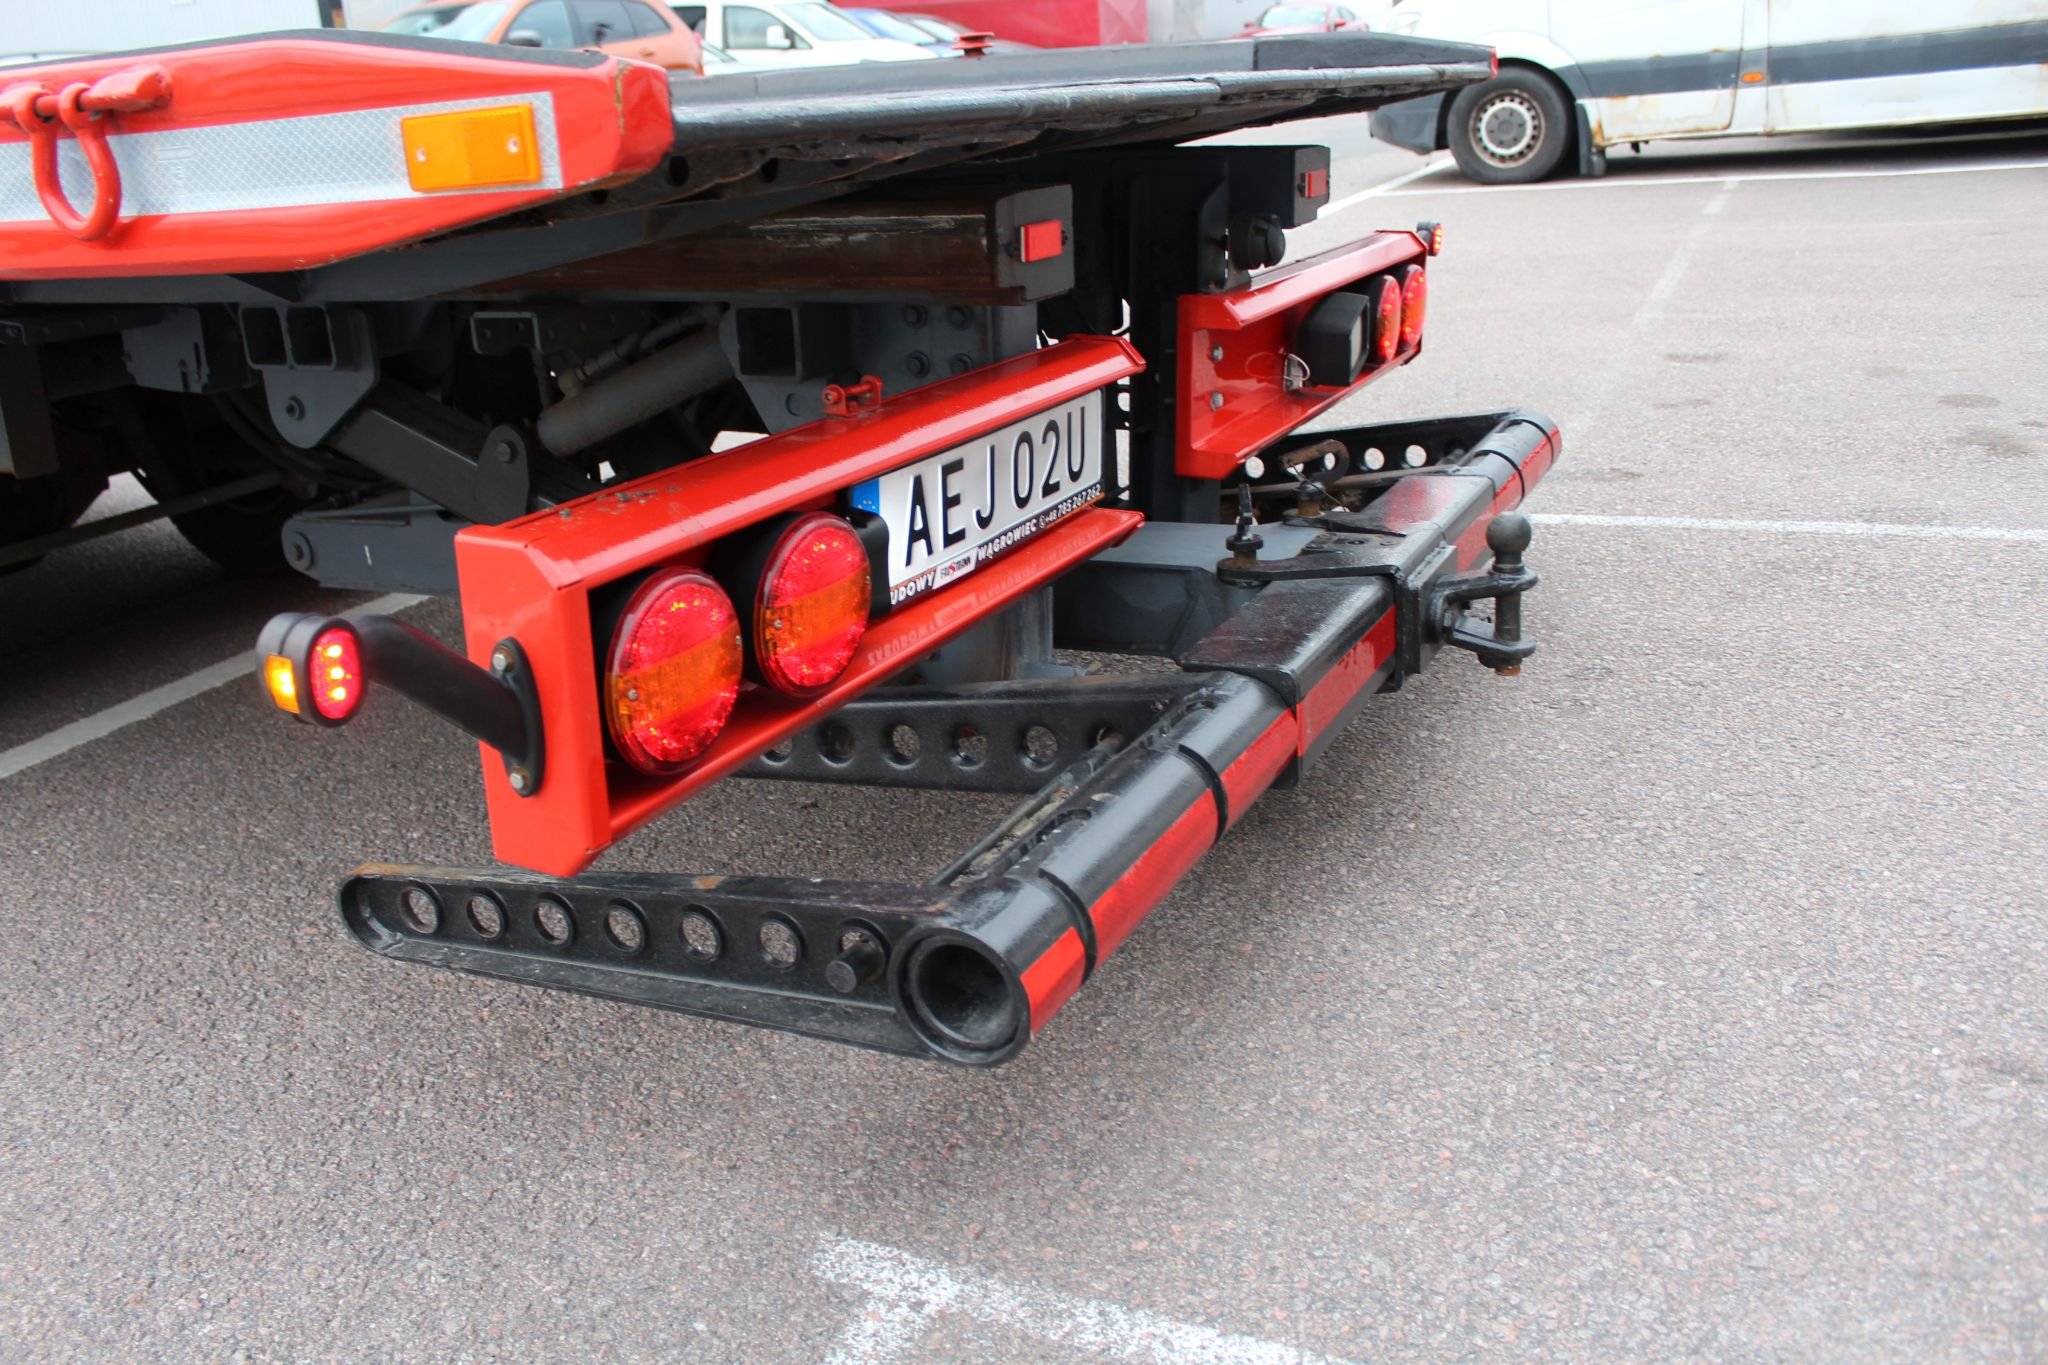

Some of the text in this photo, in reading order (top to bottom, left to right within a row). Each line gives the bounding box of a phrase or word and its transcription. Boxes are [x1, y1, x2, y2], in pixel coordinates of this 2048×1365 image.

[890, 571, 935, 605] UDOWY
[978, 518, 1037, 561] WĄGROWIEC
[1058, 499, 1072, 517] 785
[1087, 483, 1101, 501] 262
[904, 445, 996, 567] AEJ
[1013, 405, 1086, 510] 02U
